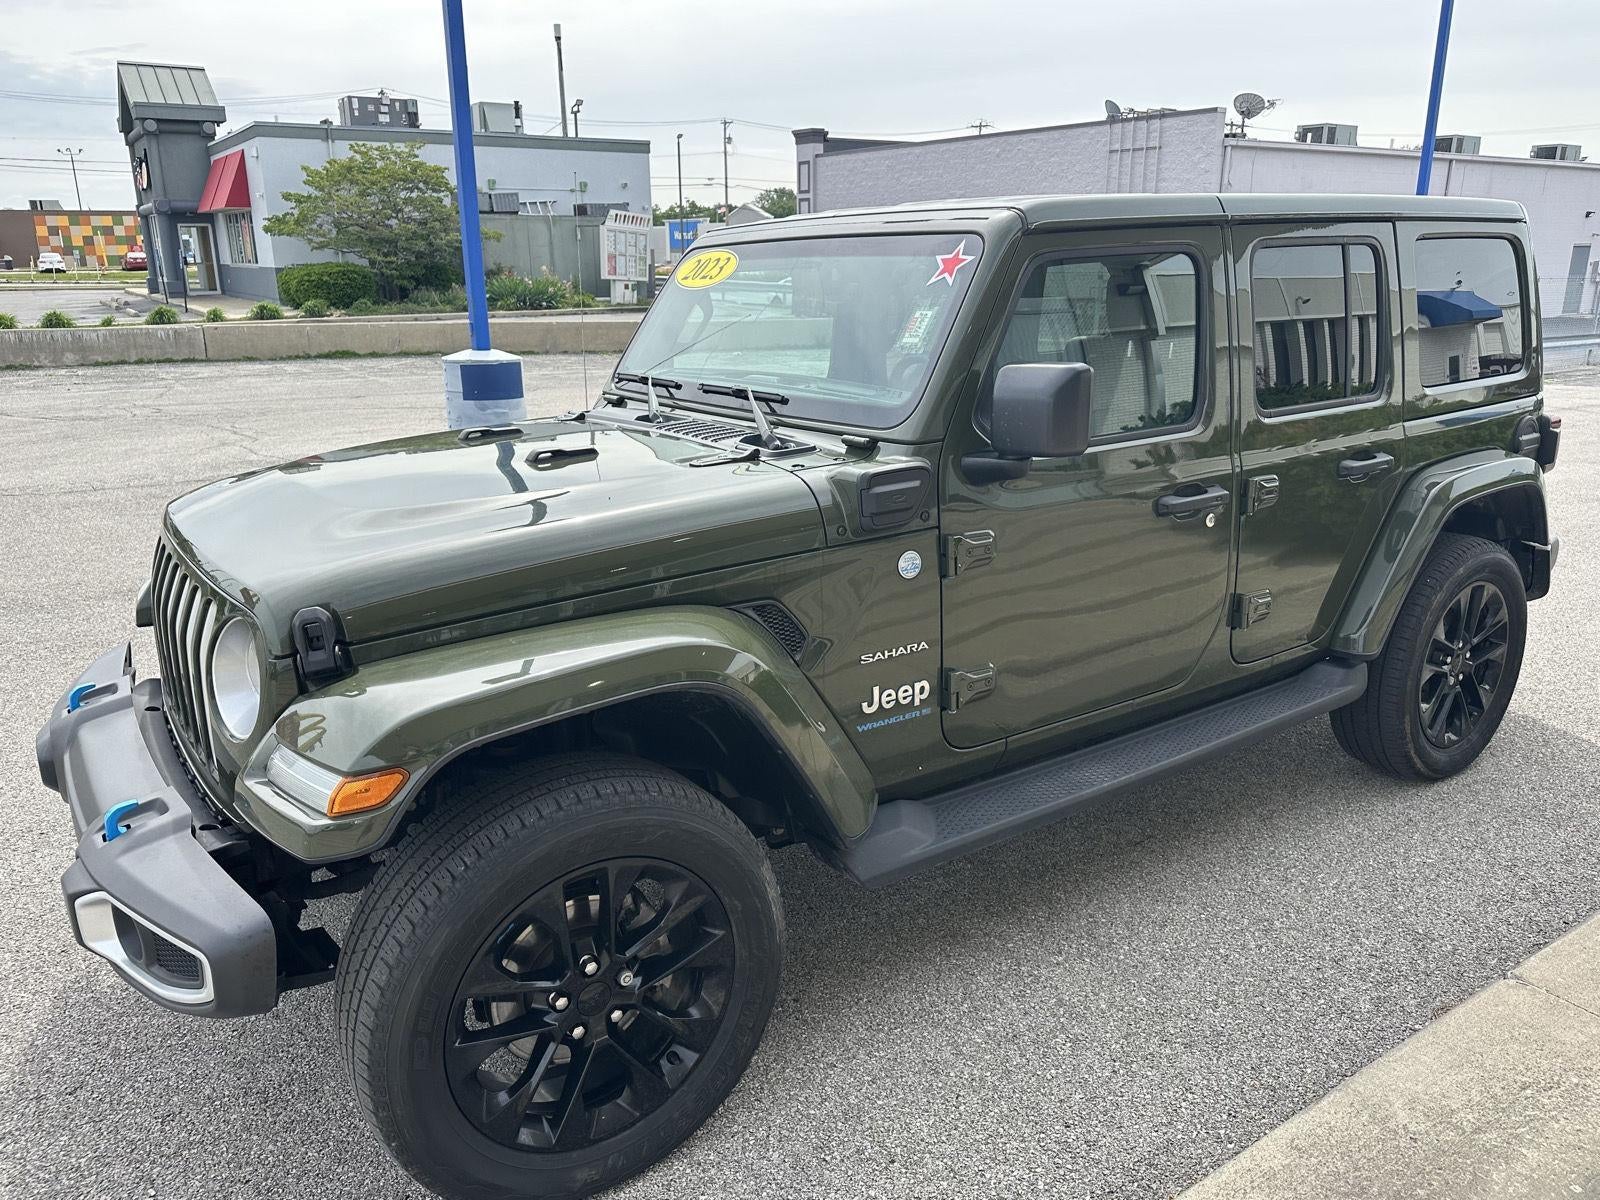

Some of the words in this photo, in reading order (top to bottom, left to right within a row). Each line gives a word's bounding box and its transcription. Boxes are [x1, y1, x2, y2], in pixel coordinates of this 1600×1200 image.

[673, 230, 693, 240] Wamart
[681, 256, 731, 281] 2023
[860, 641, 929, 664] SAHARA
[861, 679, 930, 714] Jeep
[857, 710, 921, 732] WRANGLER
